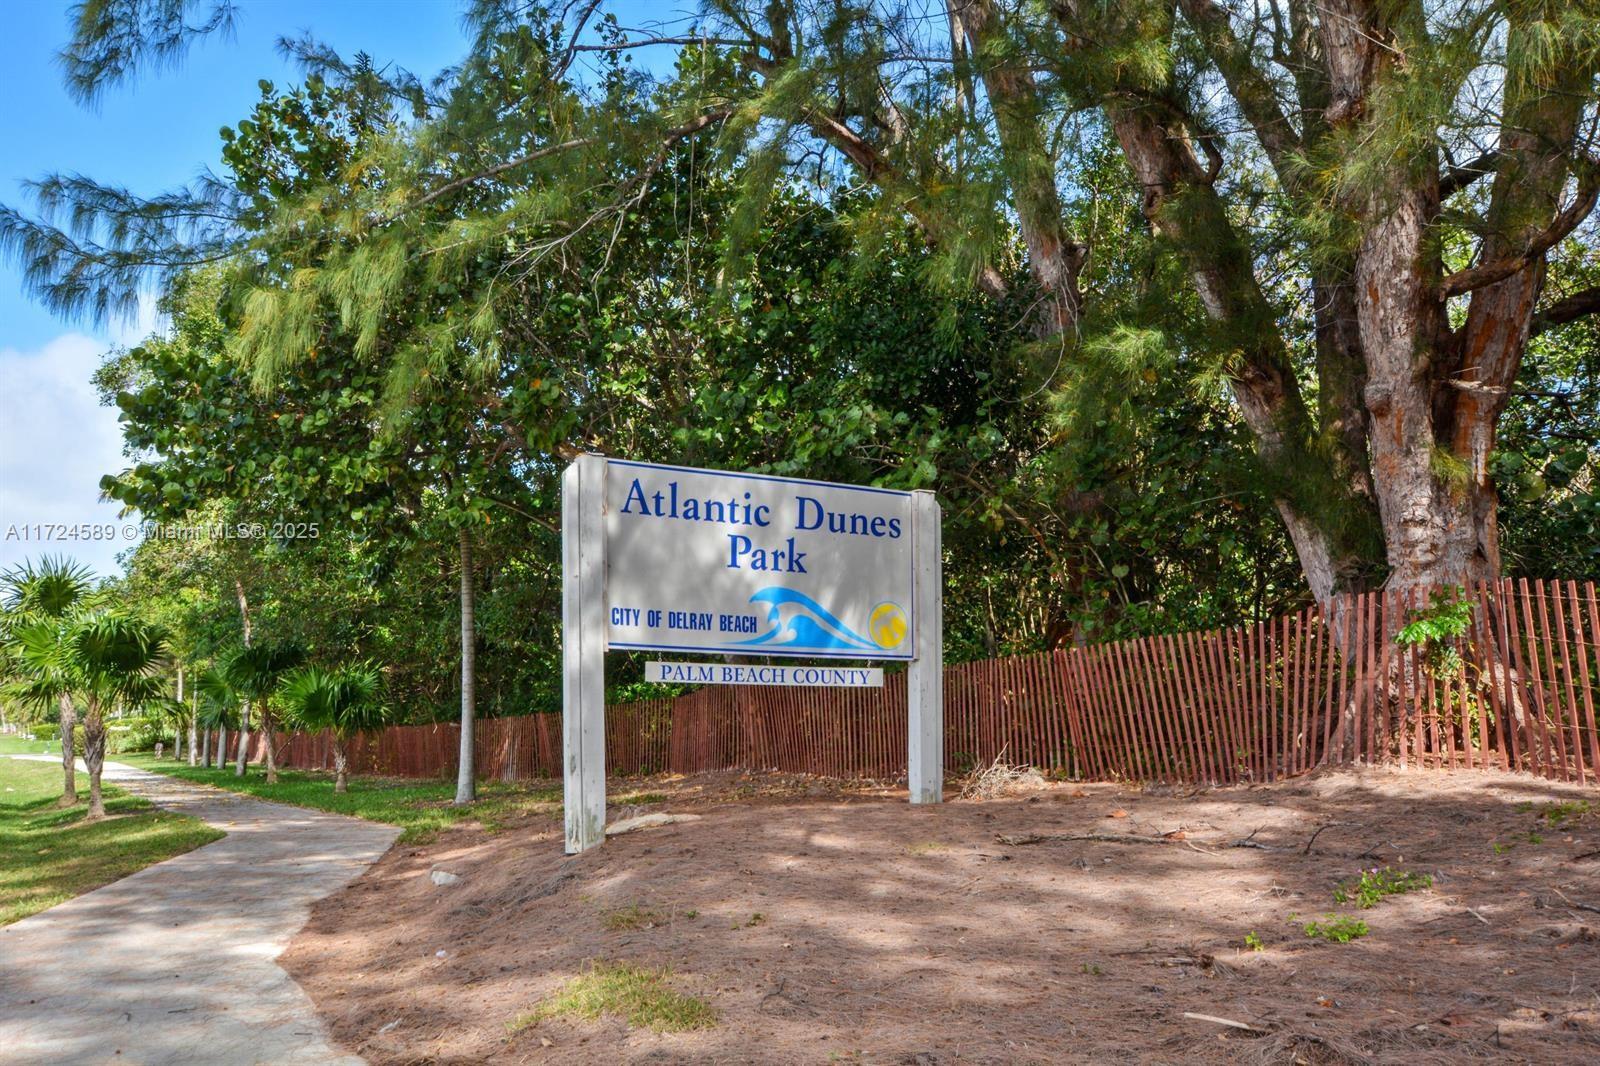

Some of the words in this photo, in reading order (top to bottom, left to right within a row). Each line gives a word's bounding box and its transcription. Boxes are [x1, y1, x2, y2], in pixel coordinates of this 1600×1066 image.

[620, 478, 770, 528] Atlantic
[795, 495, 902, 540] Dunes
[726, 533, 807, 574] Park
[611, 607, 640, 627] CITY
[647, 609, 663, 629] OF
[668, 611, 713, 632] DELRAY
[719, 614, 758, 634] BEACH
[661, 665, 715, 682] PALM
[722, 666, 786, 684] BEACH
[792, 667, 871, 686] COUNTY
